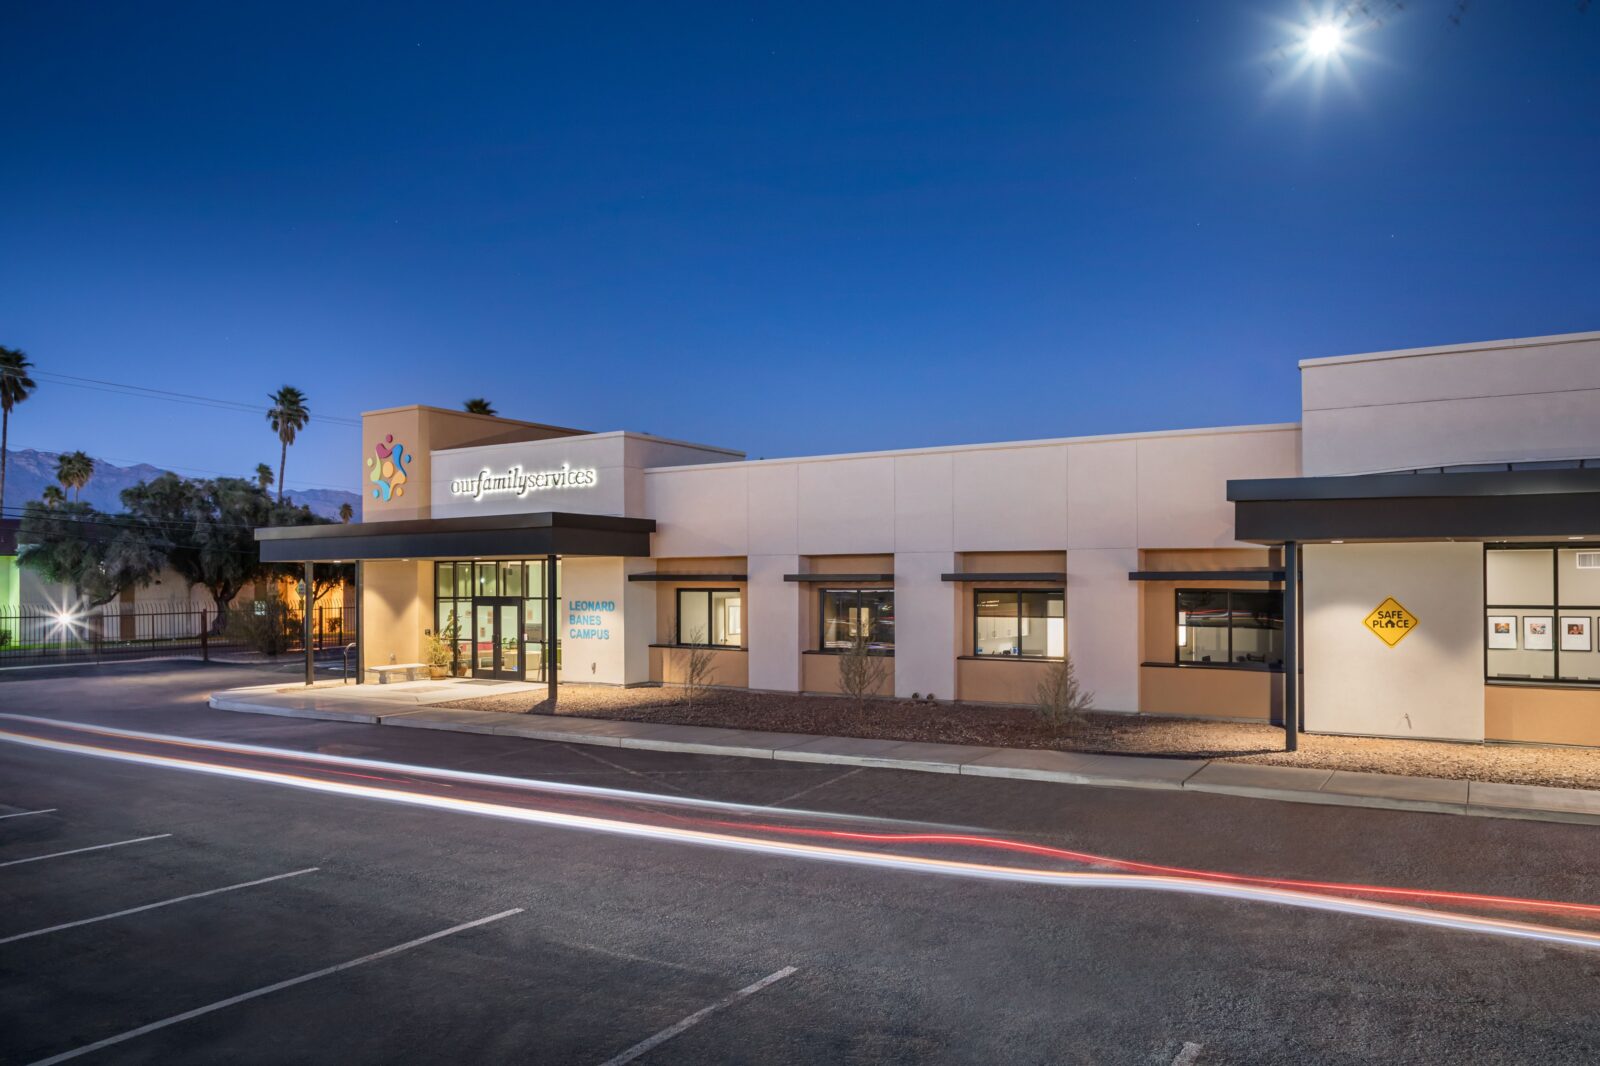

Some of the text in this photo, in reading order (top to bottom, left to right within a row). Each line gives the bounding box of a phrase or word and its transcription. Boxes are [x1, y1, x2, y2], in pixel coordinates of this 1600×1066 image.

[569, 600, 615, 612] LEONARD
[569, 614, 602, 626] BANES
[1377, 610, 1403, 620] SAFE
[569, 628, 610, 640] CAMPUS
